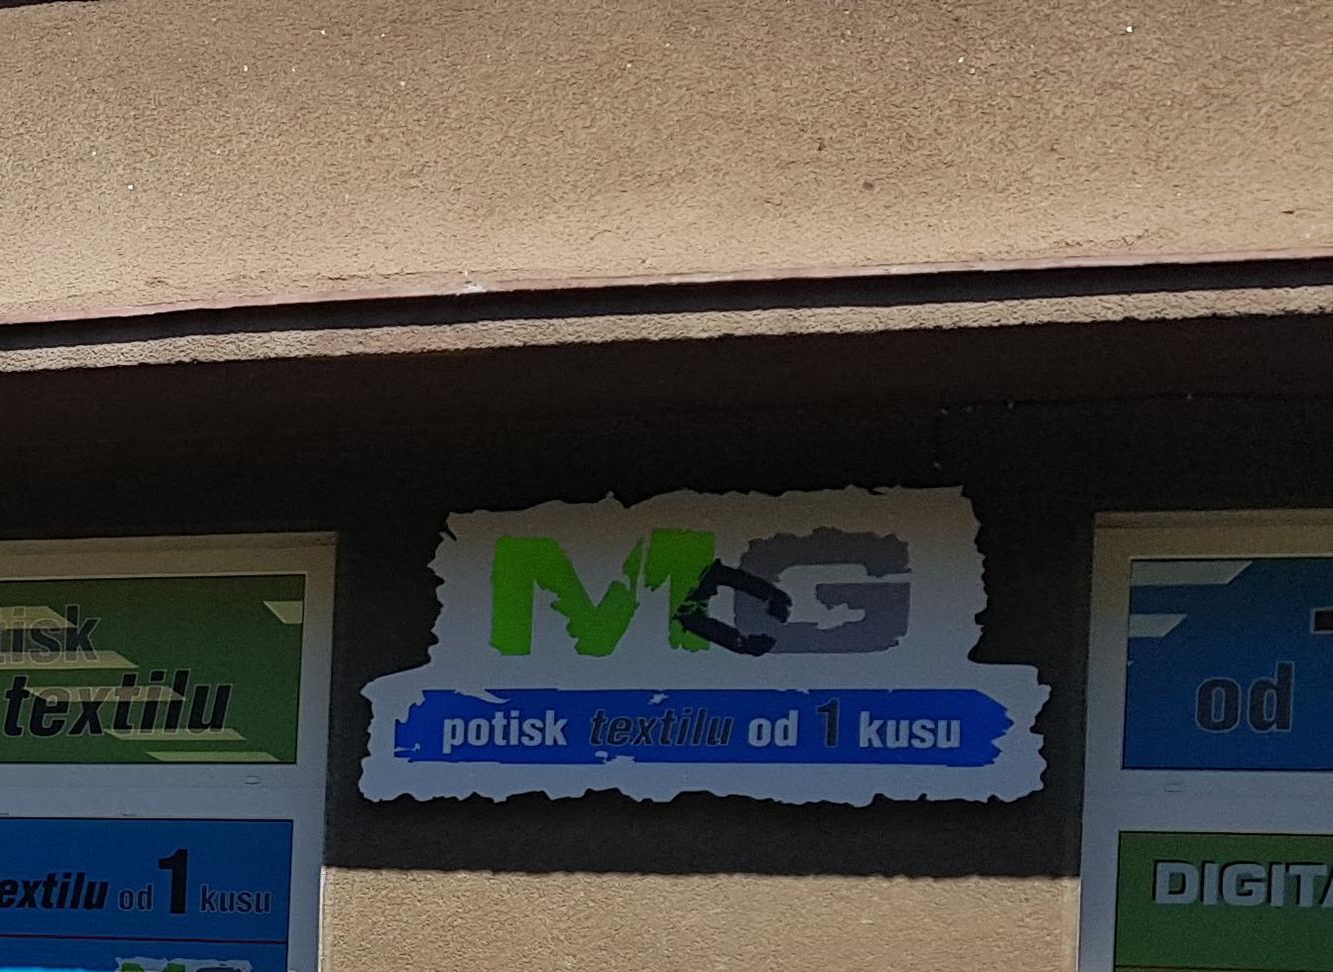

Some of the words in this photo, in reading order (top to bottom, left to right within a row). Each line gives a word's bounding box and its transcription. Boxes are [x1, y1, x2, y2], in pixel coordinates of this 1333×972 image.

[2, 669, 232, 738] textilu
[441, 708, 569, 756] potisk
[588, 706, 735, 748] textilu
[746, 716, 800, 749] od
[815, 698, 841, 748] 1
[857, 713, 963, 751] kusu
[1195, 661, 1295, 733] od
[117, 880, 154, 913] od
[157, 847, 189, 916] 1
[199, 884, 272, 915] kusu
